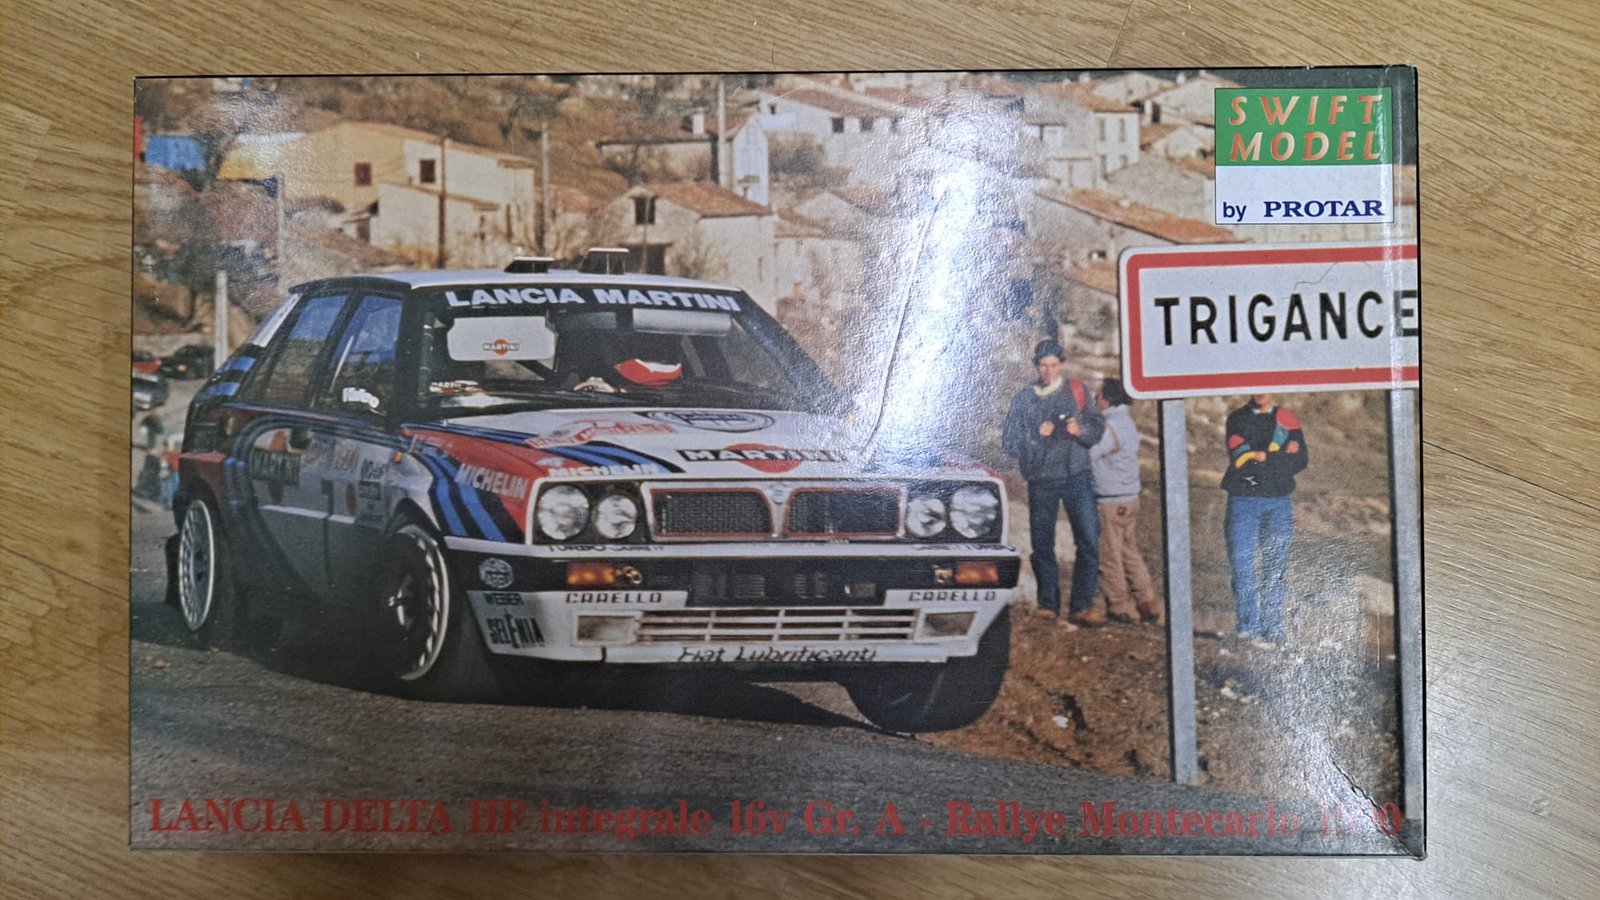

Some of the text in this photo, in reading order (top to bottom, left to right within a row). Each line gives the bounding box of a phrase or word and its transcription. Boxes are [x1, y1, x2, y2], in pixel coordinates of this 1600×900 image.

[1228, 95, 1382, 125] SWIFT
[1229, 131, 1382, 161] MODEL
[1223, 199, 1385, 222] by PROTAR
[445, 287, 741, 311] LANCIA MARTINI
[1154, 288, 1419, 347] TRIGANCE
[455, 463, 528, 498] MICHELIN
[566, 592, 662, 604] CARELLO
[908, 590, 996, 602] CARELLO
[149, 797, 307, 833] LANCIA
[320, 797, 452, 833] DELTA
[467, 798, 527, 833] HF
[538, 799, 712, 843] integrale
[803, 799, 861, 836] Gr.
[876, 799, 906, 835] A
[945, 801, 1066, 845] Rallye
[1079, 801, 1300, 836] Montecarlo
[1318, 801, 1402, 837] 10
